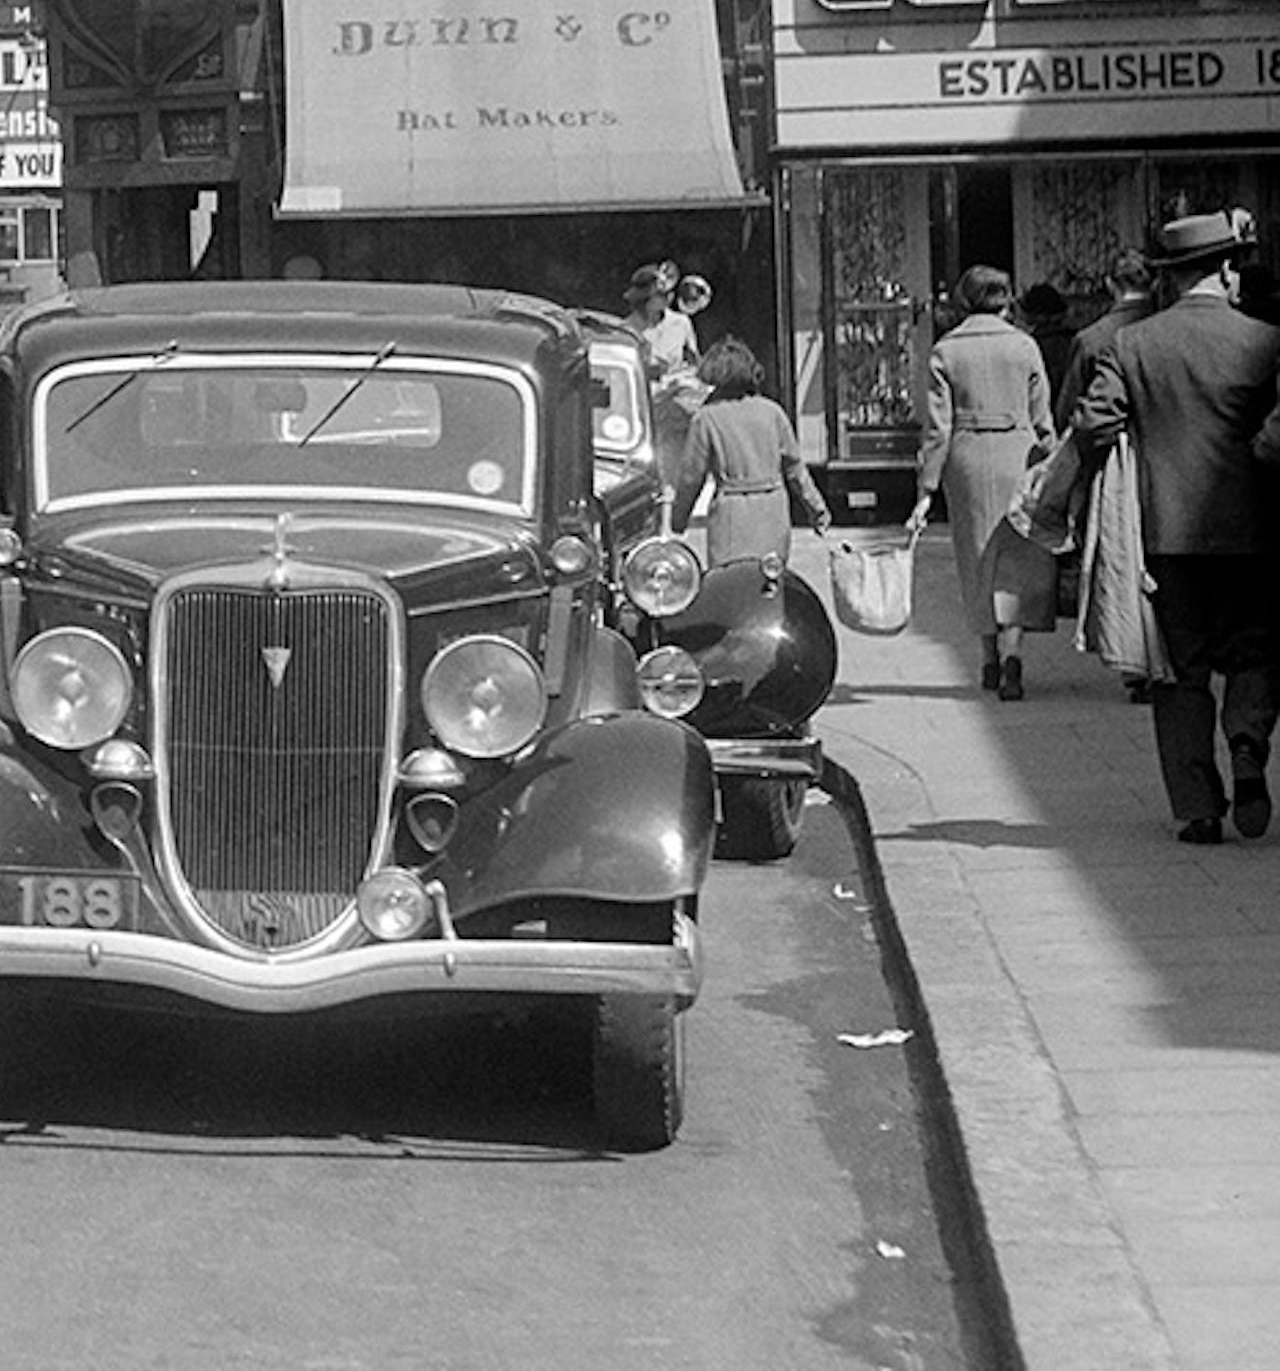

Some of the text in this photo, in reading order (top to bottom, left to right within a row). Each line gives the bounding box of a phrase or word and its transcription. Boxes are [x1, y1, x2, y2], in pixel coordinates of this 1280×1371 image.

[13, 5, 32, 24] M
[554, 15, 583, 43] &
[939, 52, 1225, 97] ESTABLISHED
[396, 109, 457, 131] Hat
[14, 152, 56, 177] YOU
[18, 876, 122, 929] 188
